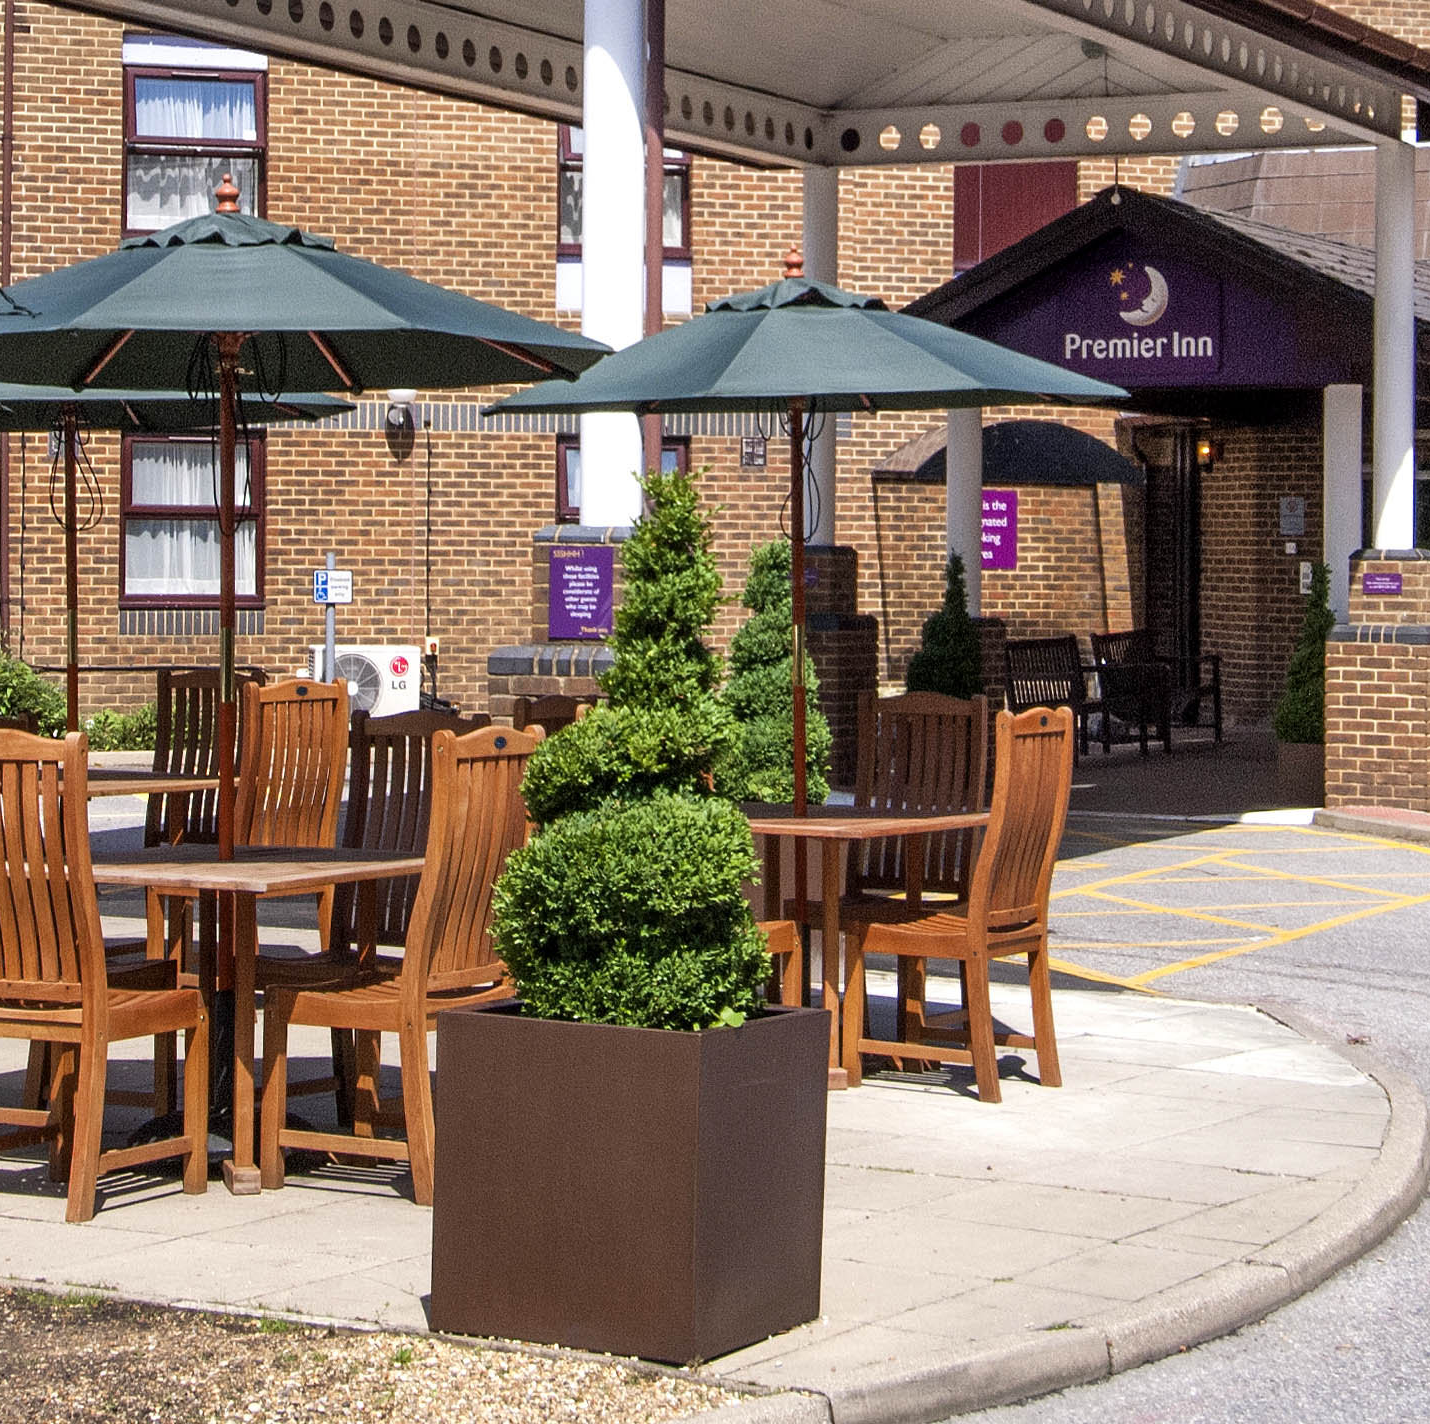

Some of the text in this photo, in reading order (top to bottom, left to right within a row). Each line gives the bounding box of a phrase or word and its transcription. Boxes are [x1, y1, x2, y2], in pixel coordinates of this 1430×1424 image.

[1065, 331, 1213, 359] Premier Inn
[982, 500, 1007, 511] is the
[981, 516, 1008, 528] nated
[981, 532, 1001, 546] king
[318, 573, 327, 585] P
[392, 680, 407, 690] LG
